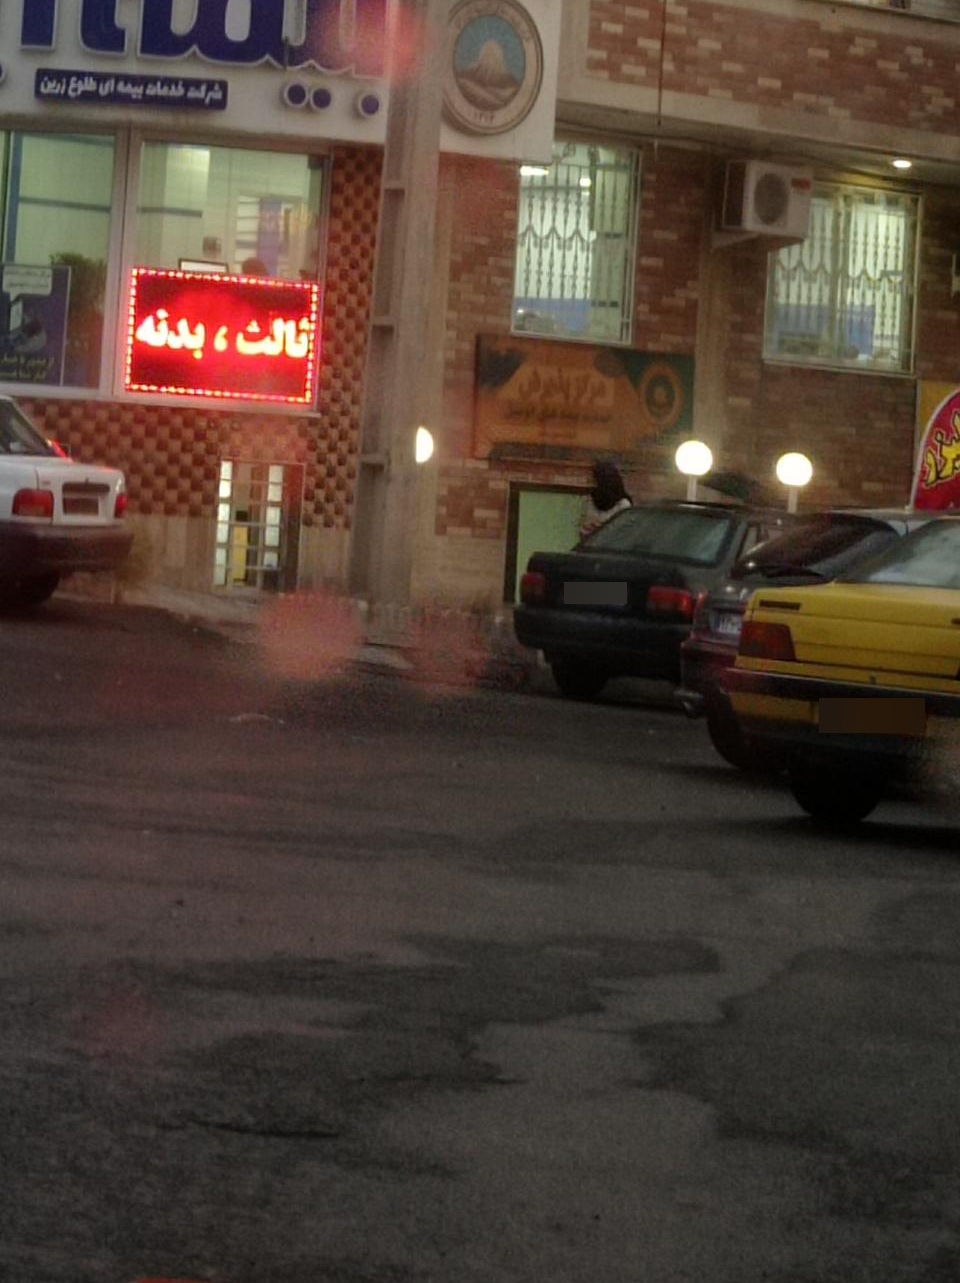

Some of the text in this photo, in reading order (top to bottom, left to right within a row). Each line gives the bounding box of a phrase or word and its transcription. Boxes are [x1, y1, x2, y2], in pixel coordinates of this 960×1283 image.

[146, 78, 185, 98] خدمات
[187, 82, 223, 105] شرکت
[136, 309, 206, 358] بدنه
[235, 318, 311, 358] ثالث
